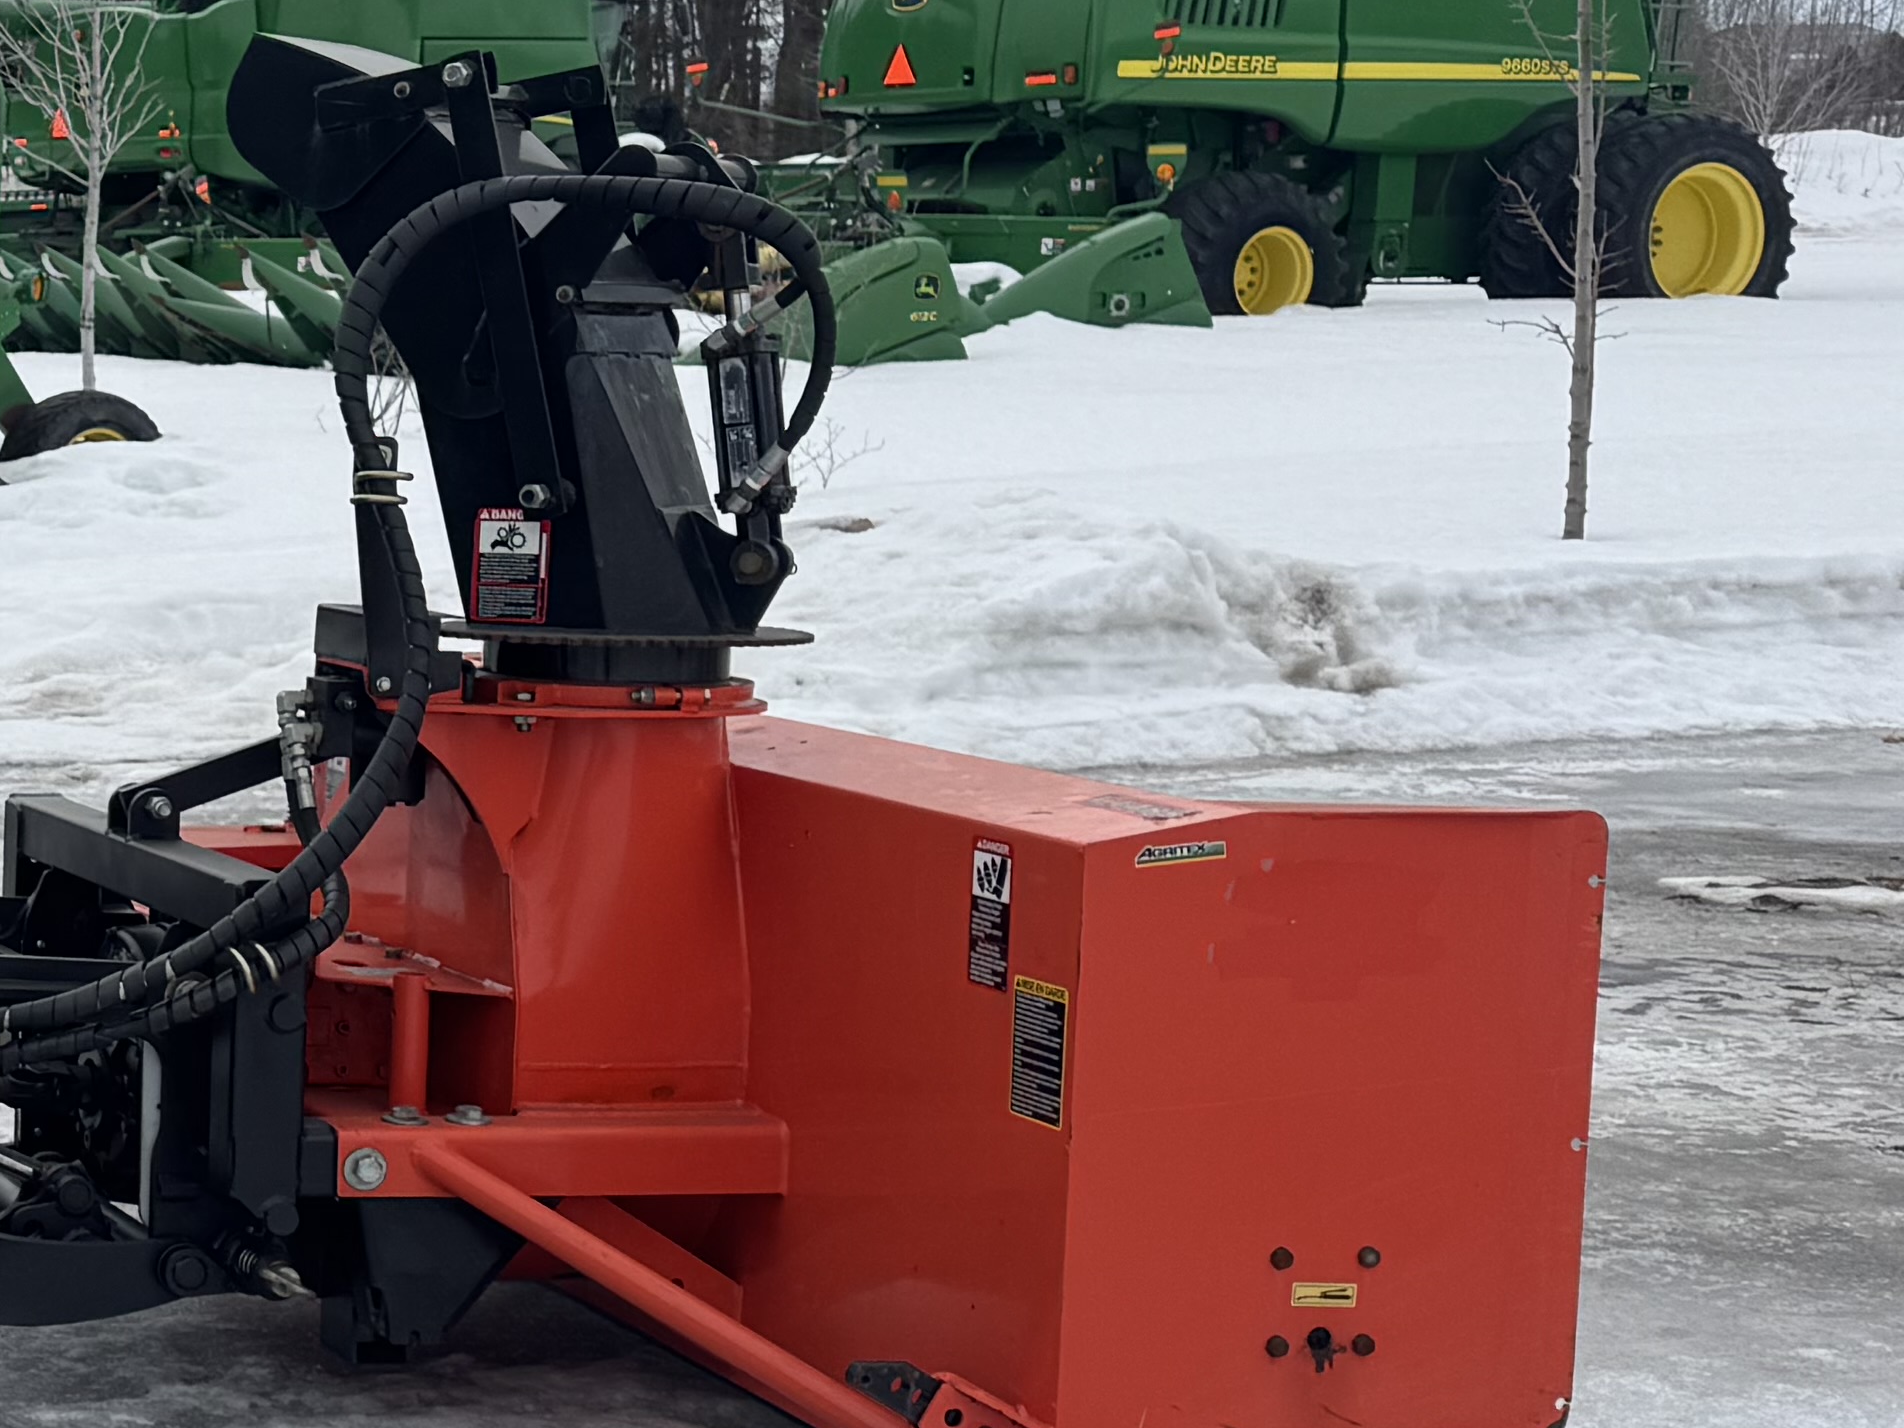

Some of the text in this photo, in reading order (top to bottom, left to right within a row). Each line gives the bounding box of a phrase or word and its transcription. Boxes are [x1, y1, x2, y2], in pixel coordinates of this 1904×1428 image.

[1151, 51, 1277, 73] JOHN DEERE
[491, 508, 524, 520] DANG
